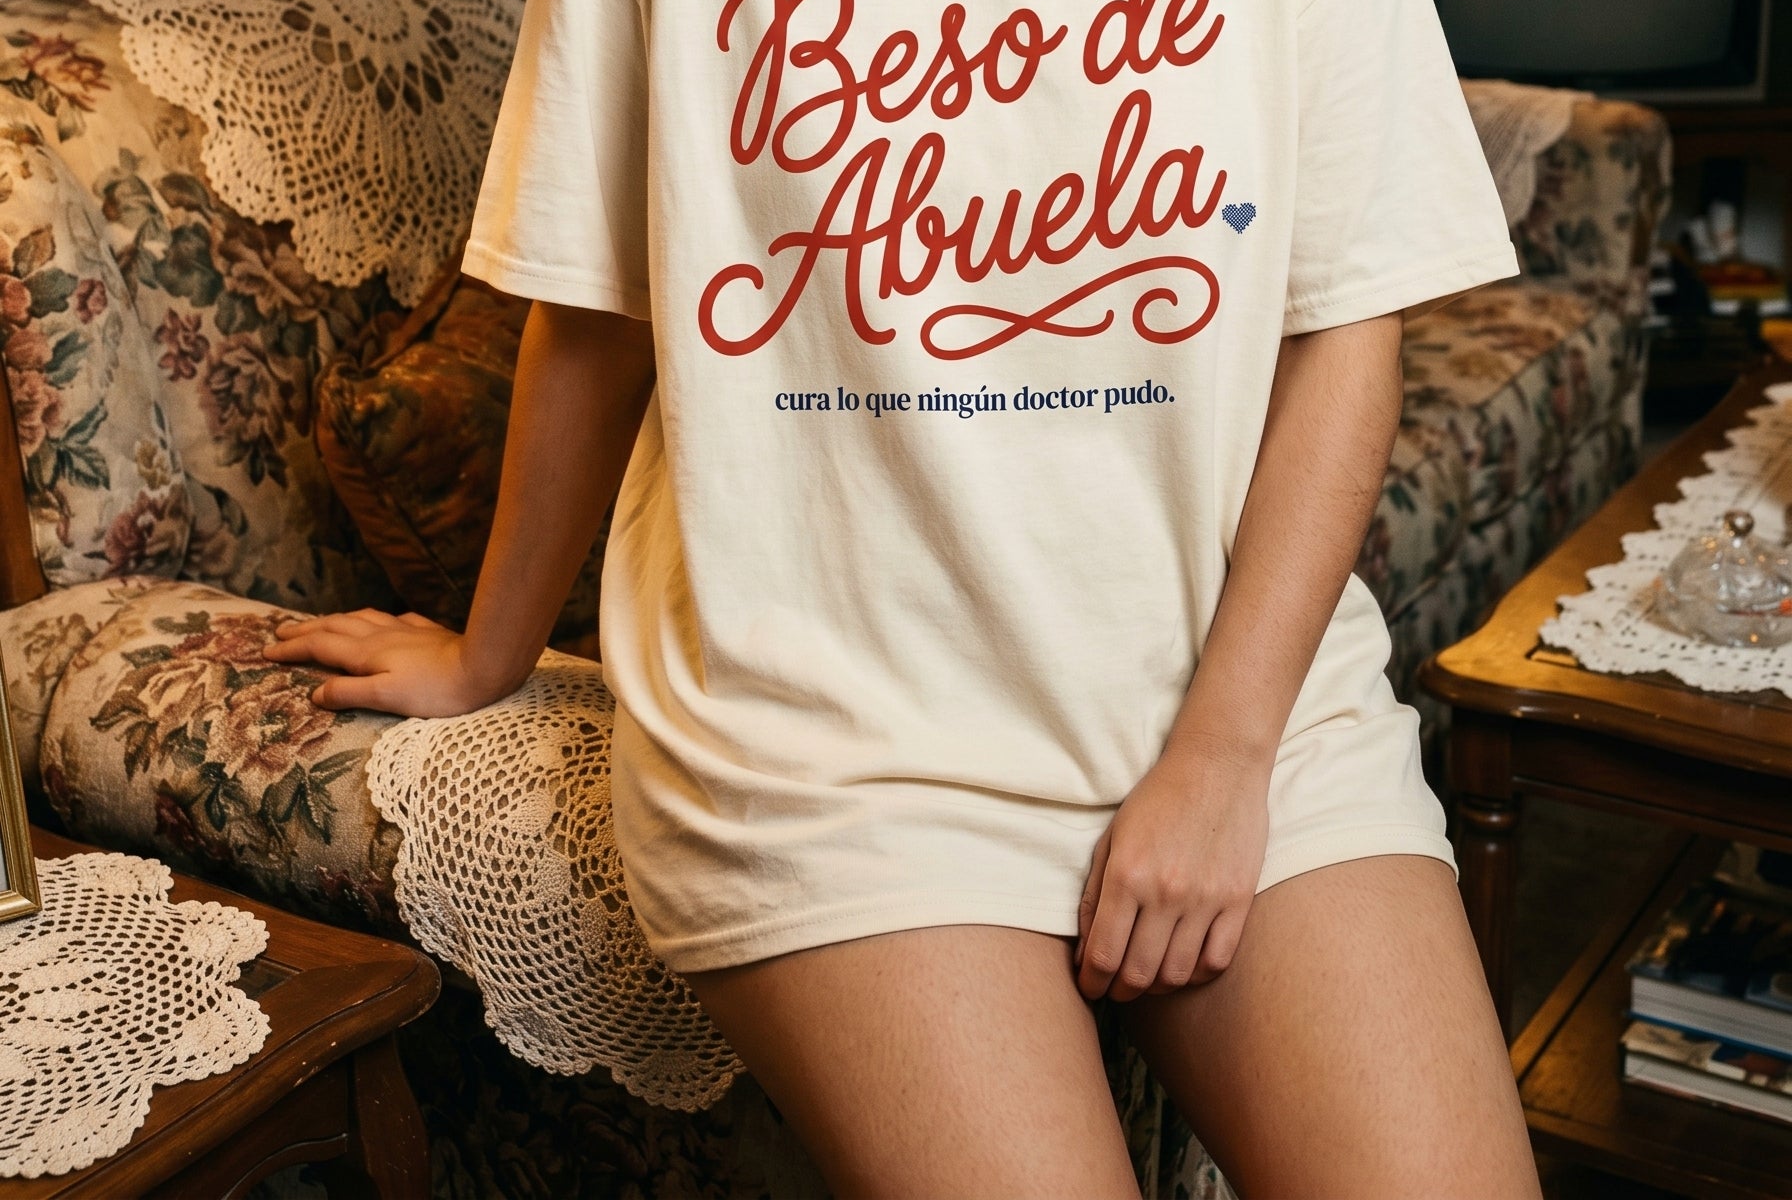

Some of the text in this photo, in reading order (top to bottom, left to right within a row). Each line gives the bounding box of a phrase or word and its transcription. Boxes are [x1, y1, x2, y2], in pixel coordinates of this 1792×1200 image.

[698, 89, 1227, 356] Abuela
[775, 379, 1175, 419] cura lo que ningún doctor pudo.
